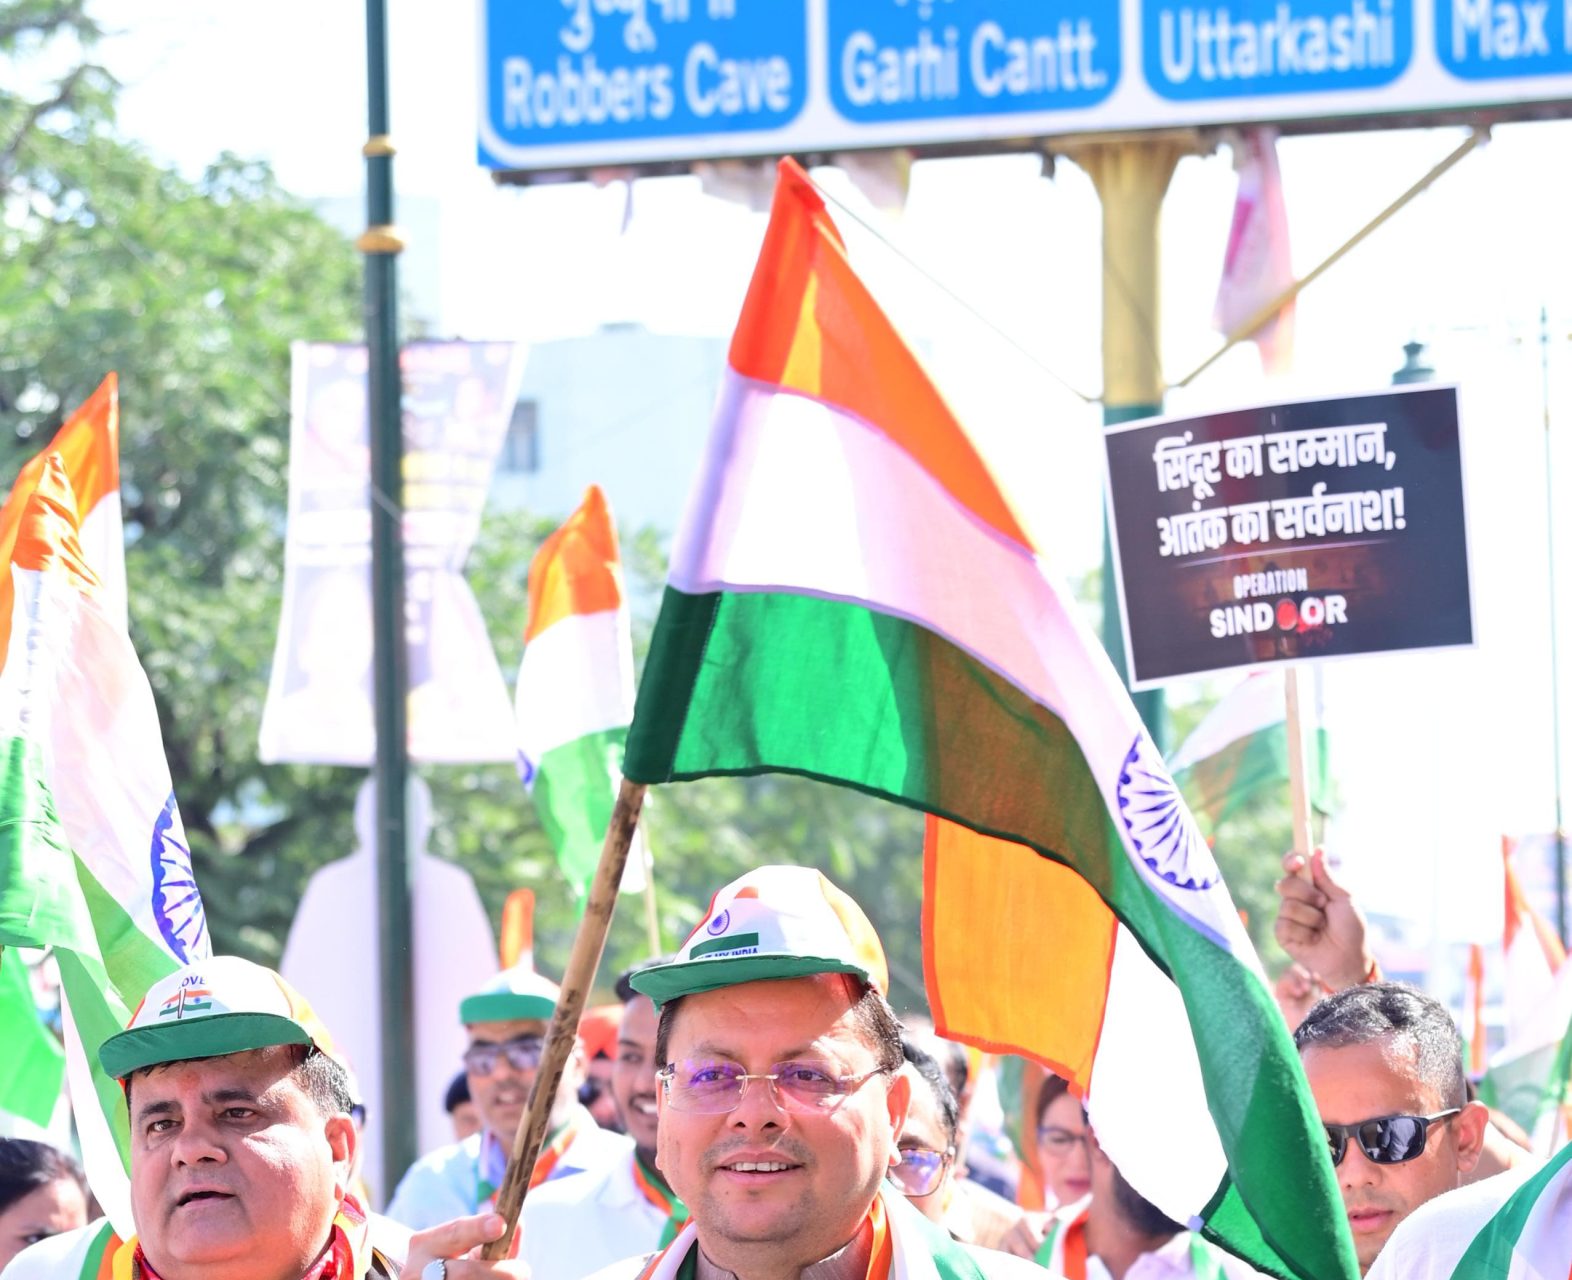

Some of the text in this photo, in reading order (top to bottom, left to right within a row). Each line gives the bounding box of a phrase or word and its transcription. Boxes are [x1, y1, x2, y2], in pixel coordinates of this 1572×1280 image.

[842, 19, 1108, 105] Garhi Cantt.
[1160, 4, 1395, 83] Uttarkashi
[1451, 0, 1550, 62] Max
[502, 41, 791, 130] Robbers Cave
[1152, 422, 1397, 500] सिंदूर का सम्मान,
[1157, 481, 1407, 556] आतंक का सर्वनाश!
[1233, 568, 1308, 599] OPERATION
[179, 975, 206, 989] OVE
